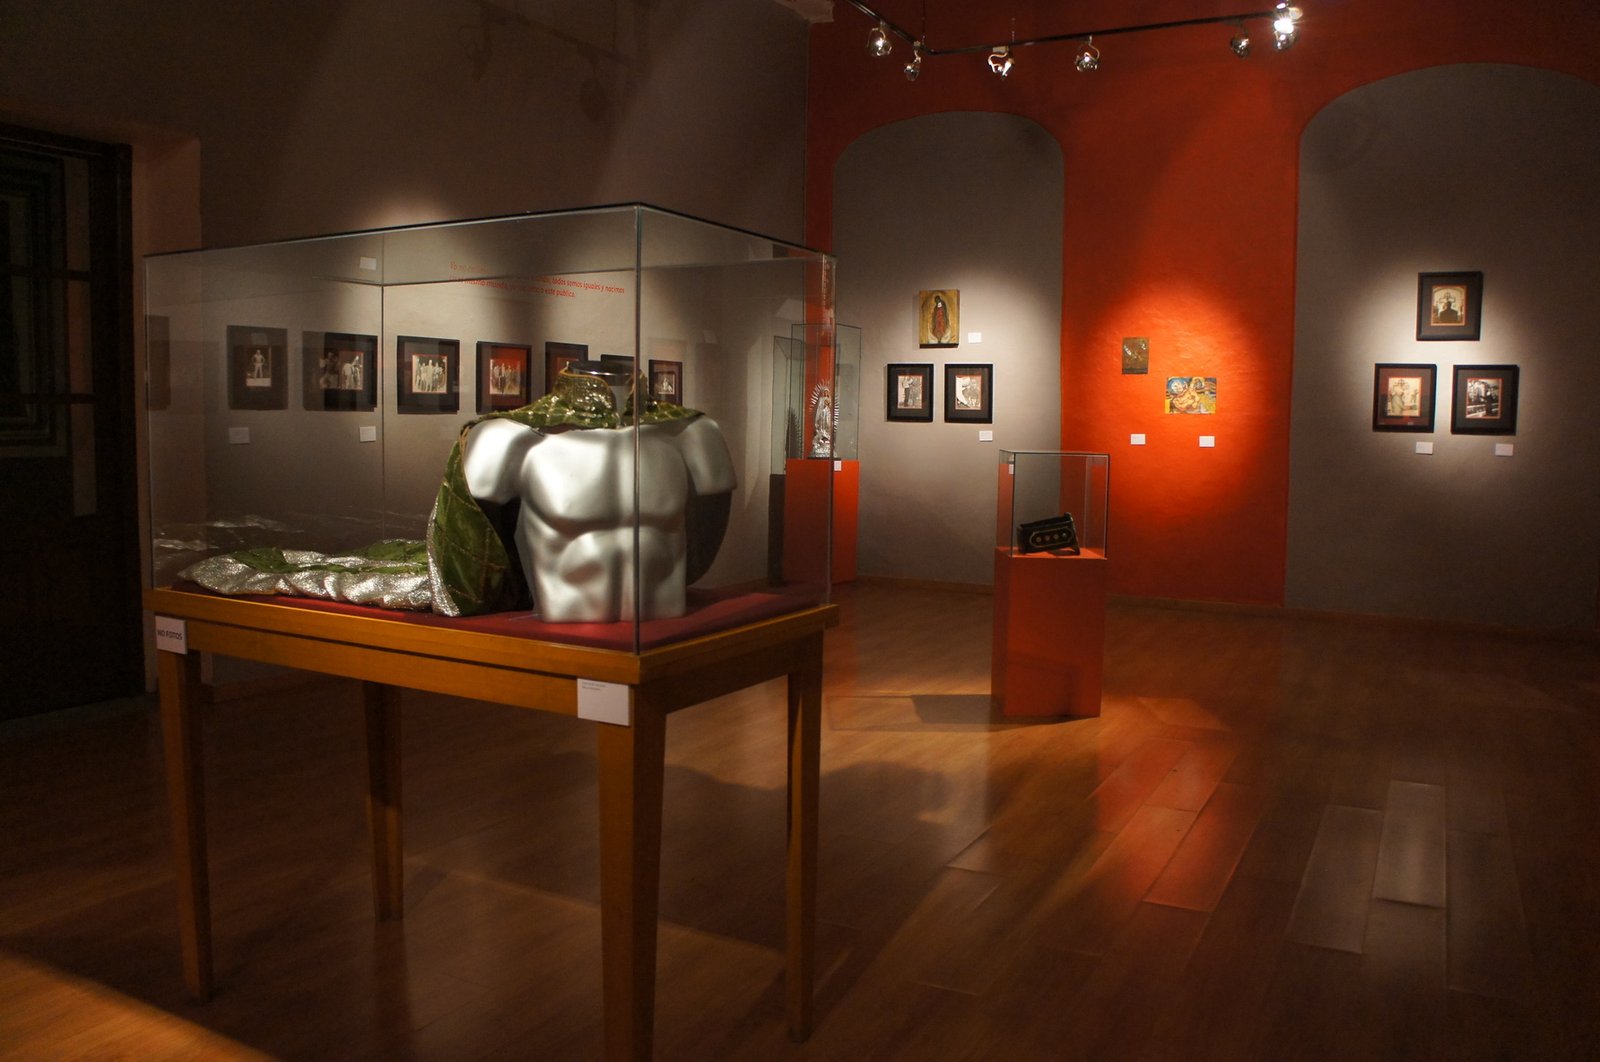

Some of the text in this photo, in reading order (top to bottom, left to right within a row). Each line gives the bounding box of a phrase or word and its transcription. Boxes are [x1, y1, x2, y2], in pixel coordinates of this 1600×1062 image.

[567, 279, 582, 288] somos
[583, 280, 600, 291] iguales
[605, 284, 625, 294] nacimos
[157, 629, 183, 641] NO FOTOS
